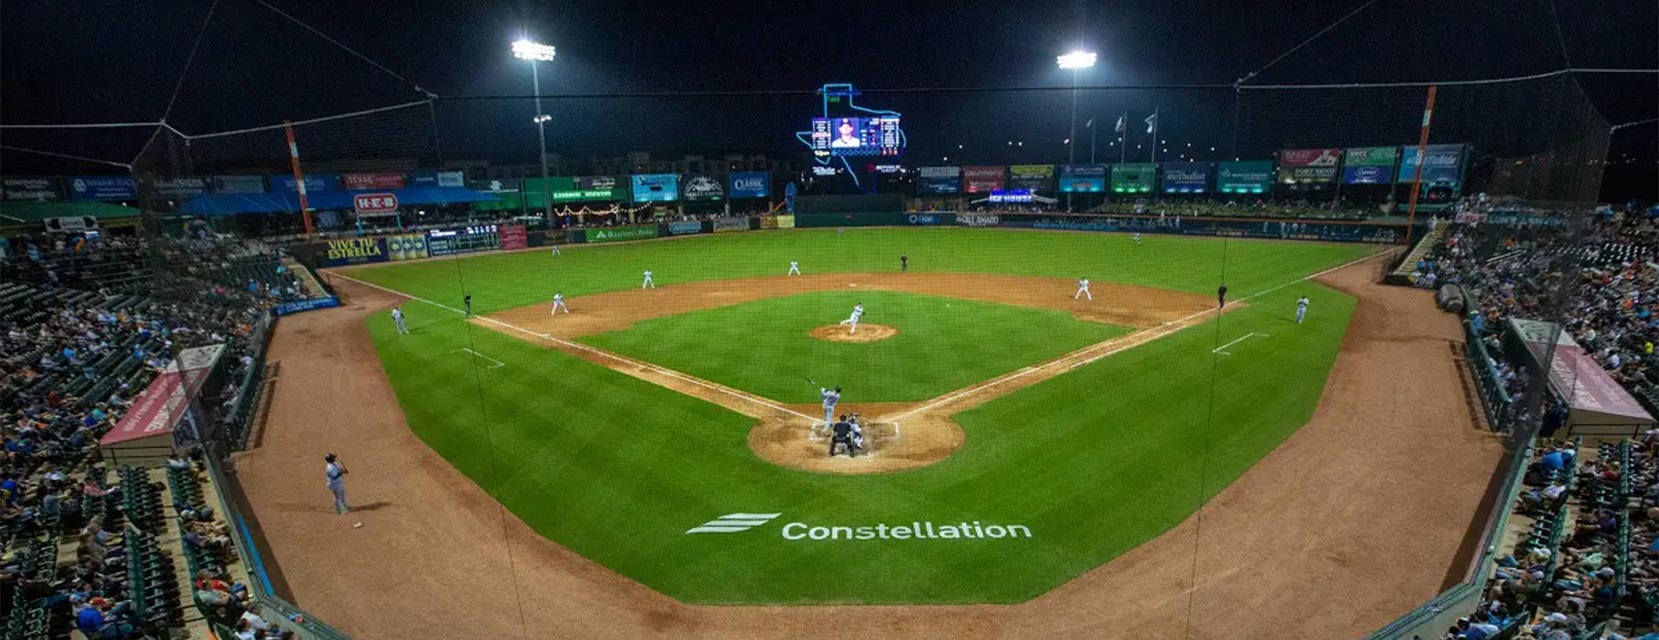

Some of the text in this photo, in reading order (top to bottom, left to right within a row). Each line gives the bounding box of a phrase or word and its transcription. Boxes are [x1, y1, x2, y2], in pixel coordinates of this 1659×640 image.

[328, 238, 373, 250] VIVE TU
[328, 247, 381, 259] ESTRELLA
[782, 520, 1032, 540] Constellation
